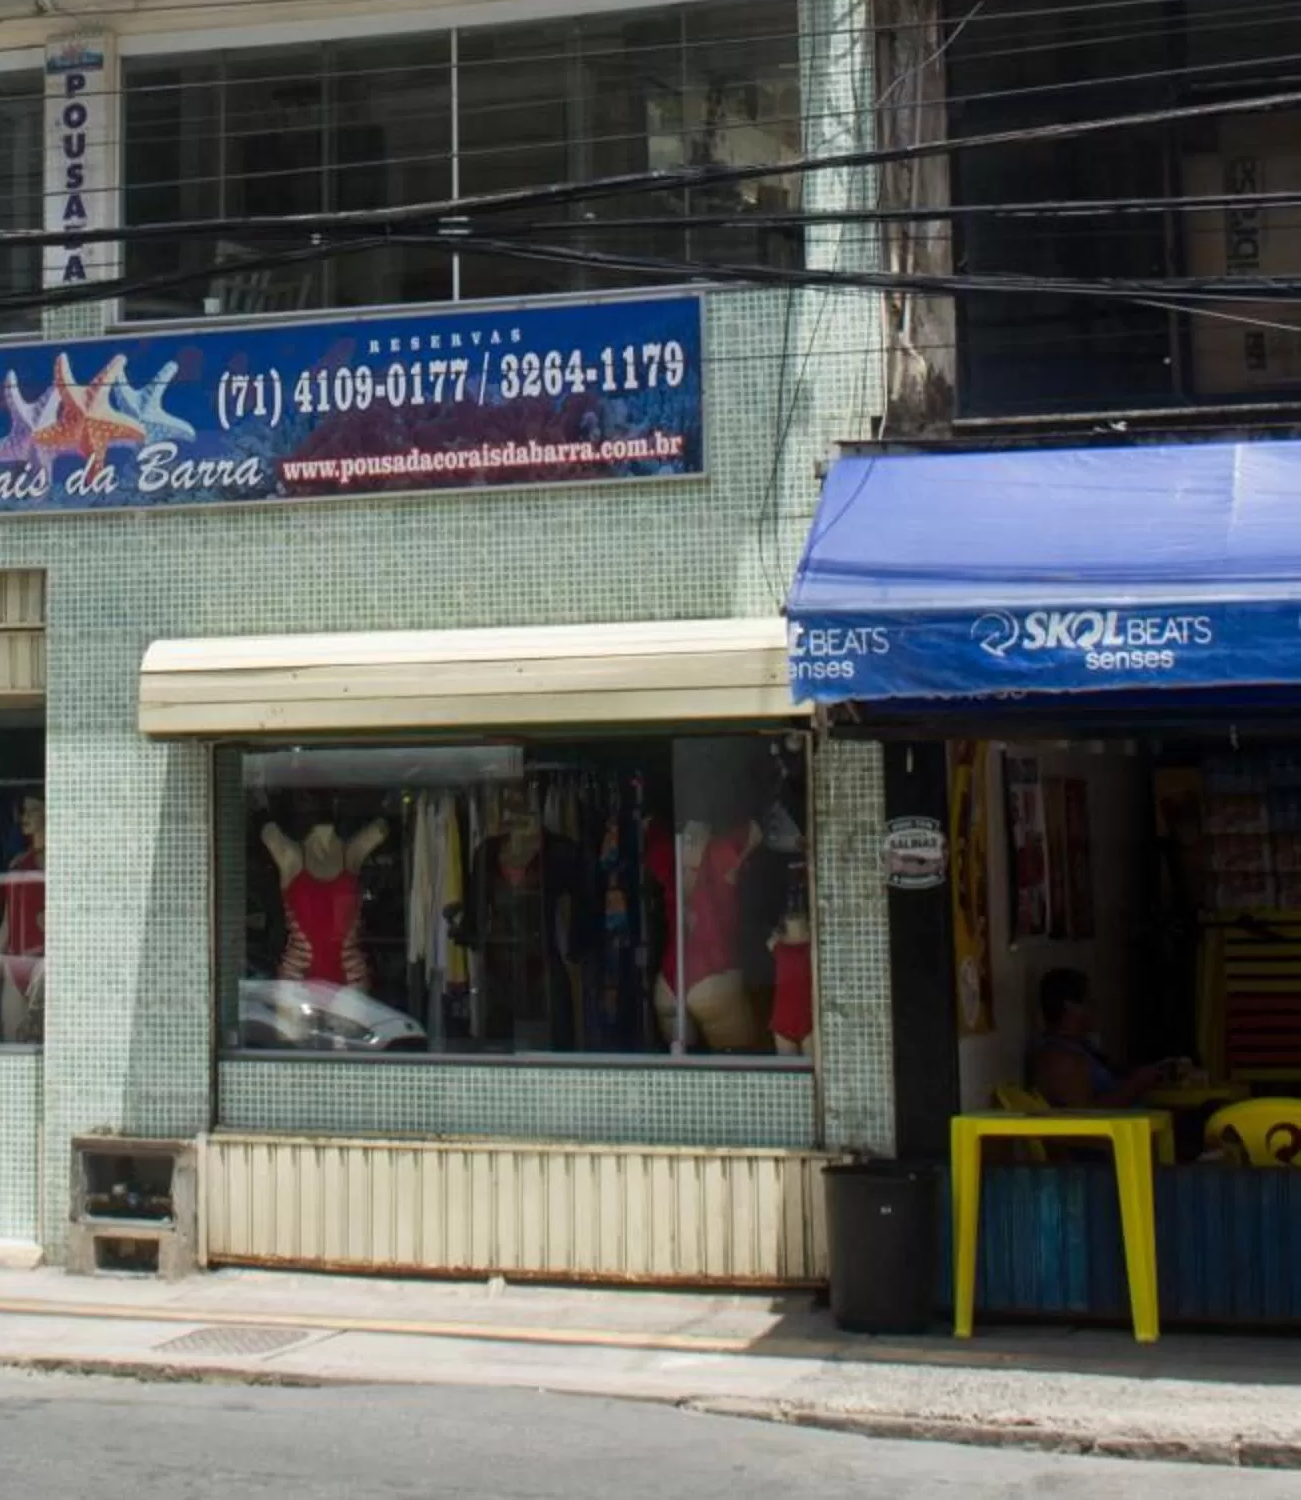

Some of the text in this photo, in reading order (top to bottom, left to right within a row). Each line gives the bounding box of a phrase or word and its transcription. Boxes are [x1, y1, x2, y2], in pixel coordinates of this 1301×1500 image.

[368, 327, 523, 354] RESERVAS
[216, 340, 686, 431] (71) 4109-0177 / 3264-1179
[65, 456, 118, 496] da
[136, 441, 263, 493] Barra
[282, 432, 683, 483] www.pousadacoraisdabarra.com.br
[809, 626, 891, 657] BEATS
[1021, 610, 1212, 651] SKOL BEATS
[1085, 648, 1176, 671] senses
